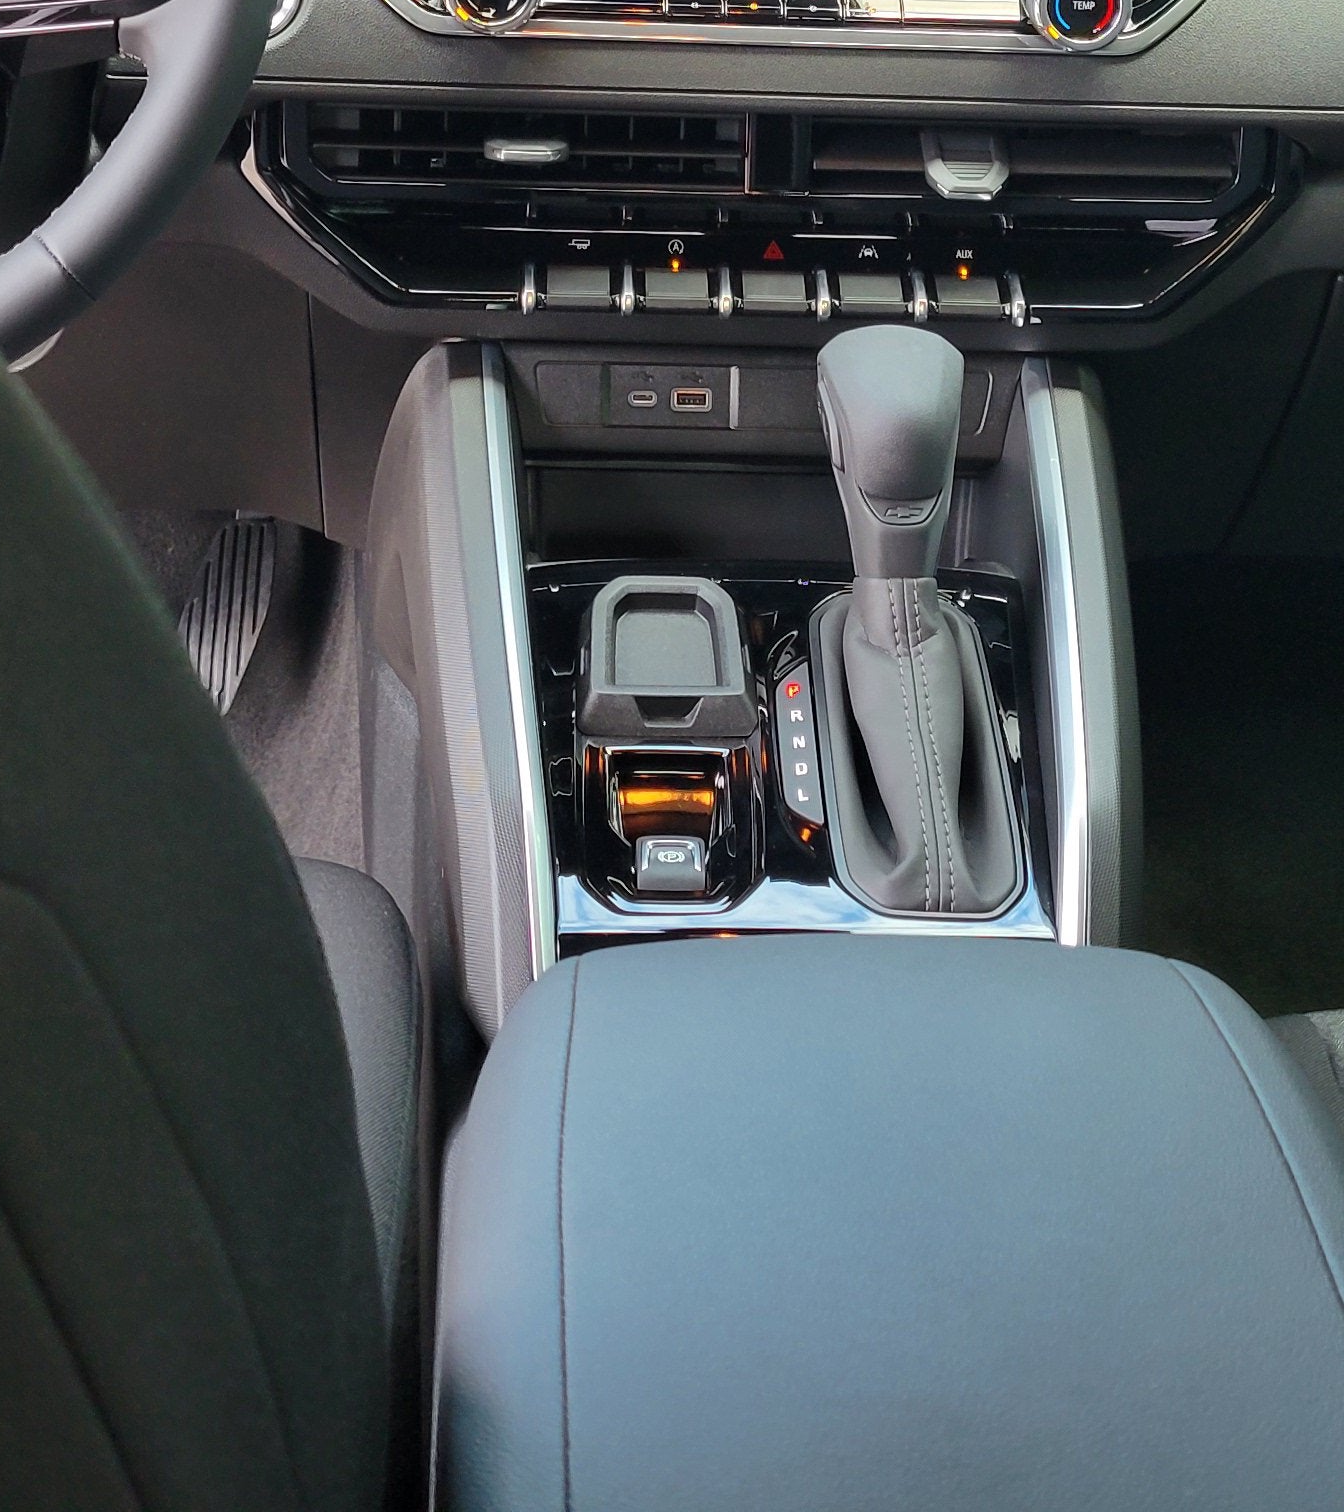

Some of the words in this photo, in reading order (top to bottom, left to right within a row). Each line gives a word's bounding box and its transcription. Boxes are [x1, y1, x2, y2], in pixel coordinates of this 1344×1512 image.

[1072, 0, 1095, 11] TEMP
[956, 249, 973, 259] AUX
[786, 683, 800, 698] P
[790, 710, 804, 722] R
[792, 735, 806, 749] N
[795, 763, 808, 776] D
[797, 789, 809, 802] L
